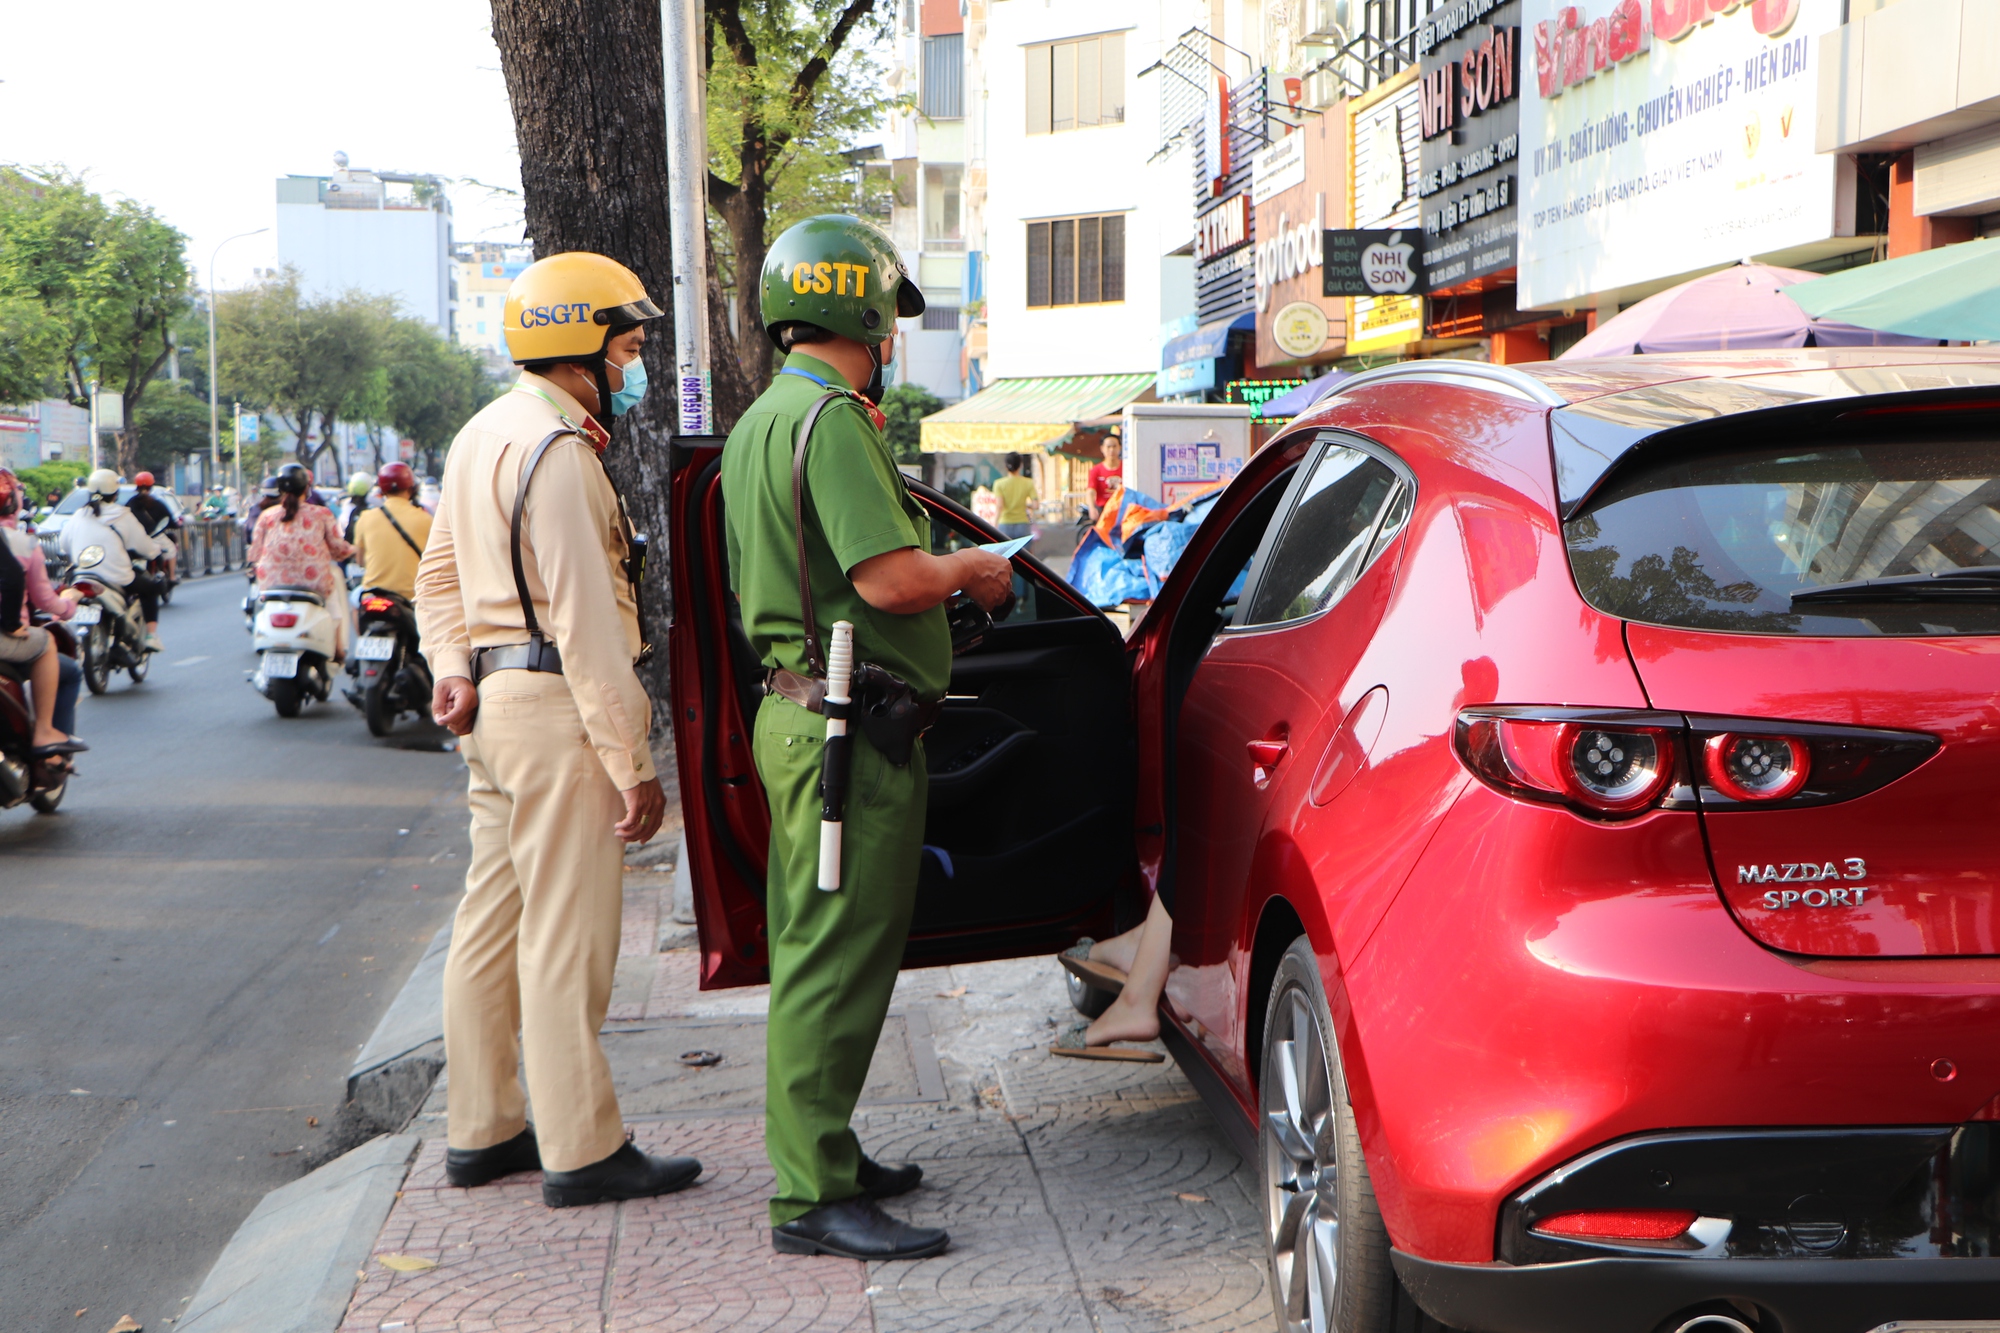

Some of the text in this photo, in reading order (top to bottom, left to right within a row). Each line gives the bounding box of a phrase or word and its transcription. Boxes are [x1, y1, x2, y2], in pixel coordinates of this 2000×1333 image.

[1419, 24, 1514, 145] NHỊ SƠN
[1534, 147, 1545, 178] UY
[1547, 136, 1561, 172] TÍN
[1569, 118, 1594, 163] CHẤT
[1596, 111, 1628, 155] LƯỢNG
[1637, 85, 1683, 137] CHUYÊN
[1686, 64, 1733, 116] NGHIỆP
[1744, 45, 1778, 95] HIỆN
[1782, 35, 1808, 82] ĐẠI
[1534, 210, 1546, 229] TOP
[1547, 205, 1561, 224] TEN
[1563, 196, 1585, 220] HÀNG
[1605, 179, 1635, 205] NGÀNH
[1638, 175, 1649, 195] DA
[1700, 149, 1722, 172] NAM
[1334, 236, 1357, 247] MUA
[1333, 250, 1358, 263] ĐIỆN
[1371, 251, 1402, 268] NHỊ
[793, 261, 870, 298] CSTT
[1327, 280, 1365, 292] GIÁ CAO
[1370, 269, 1406, 284] SƠN
[520, 303, 591, 329] CSGT
[1241, 387, 1272, 404] THỊT
[1762, 886, 1869, 910] SPORT
